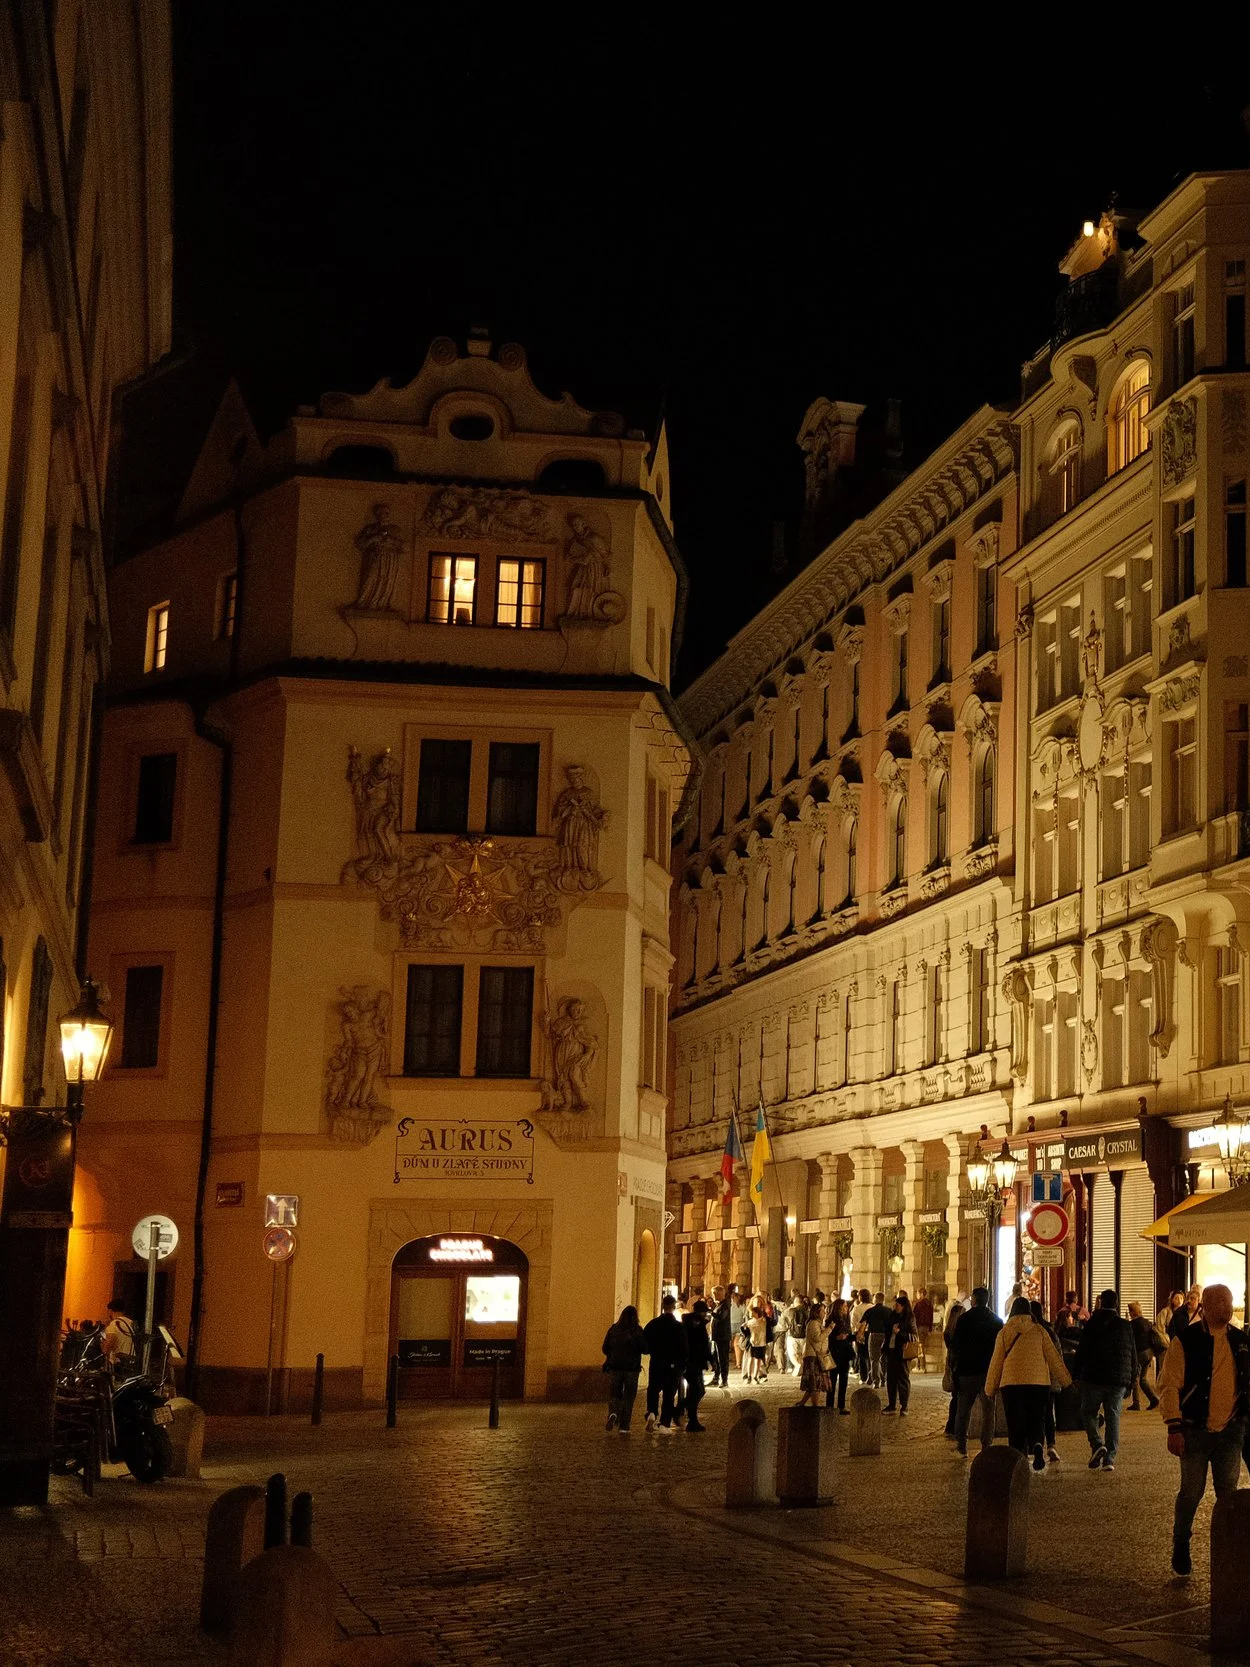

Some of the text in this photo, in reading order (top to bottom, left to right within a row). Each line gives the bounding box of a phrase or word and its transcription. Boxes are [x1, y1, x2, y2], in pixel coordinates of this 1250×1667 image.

[420, 1127, 513, 1151] AURUS
[1068, 1139, 1138, 1160] CAESAR CRYSTAL
[432, 1159, 440, 1169] U
[442, 1156, 480, 1169] ZLATÉ
[482, 1159, 528, 1169] STUDNY
